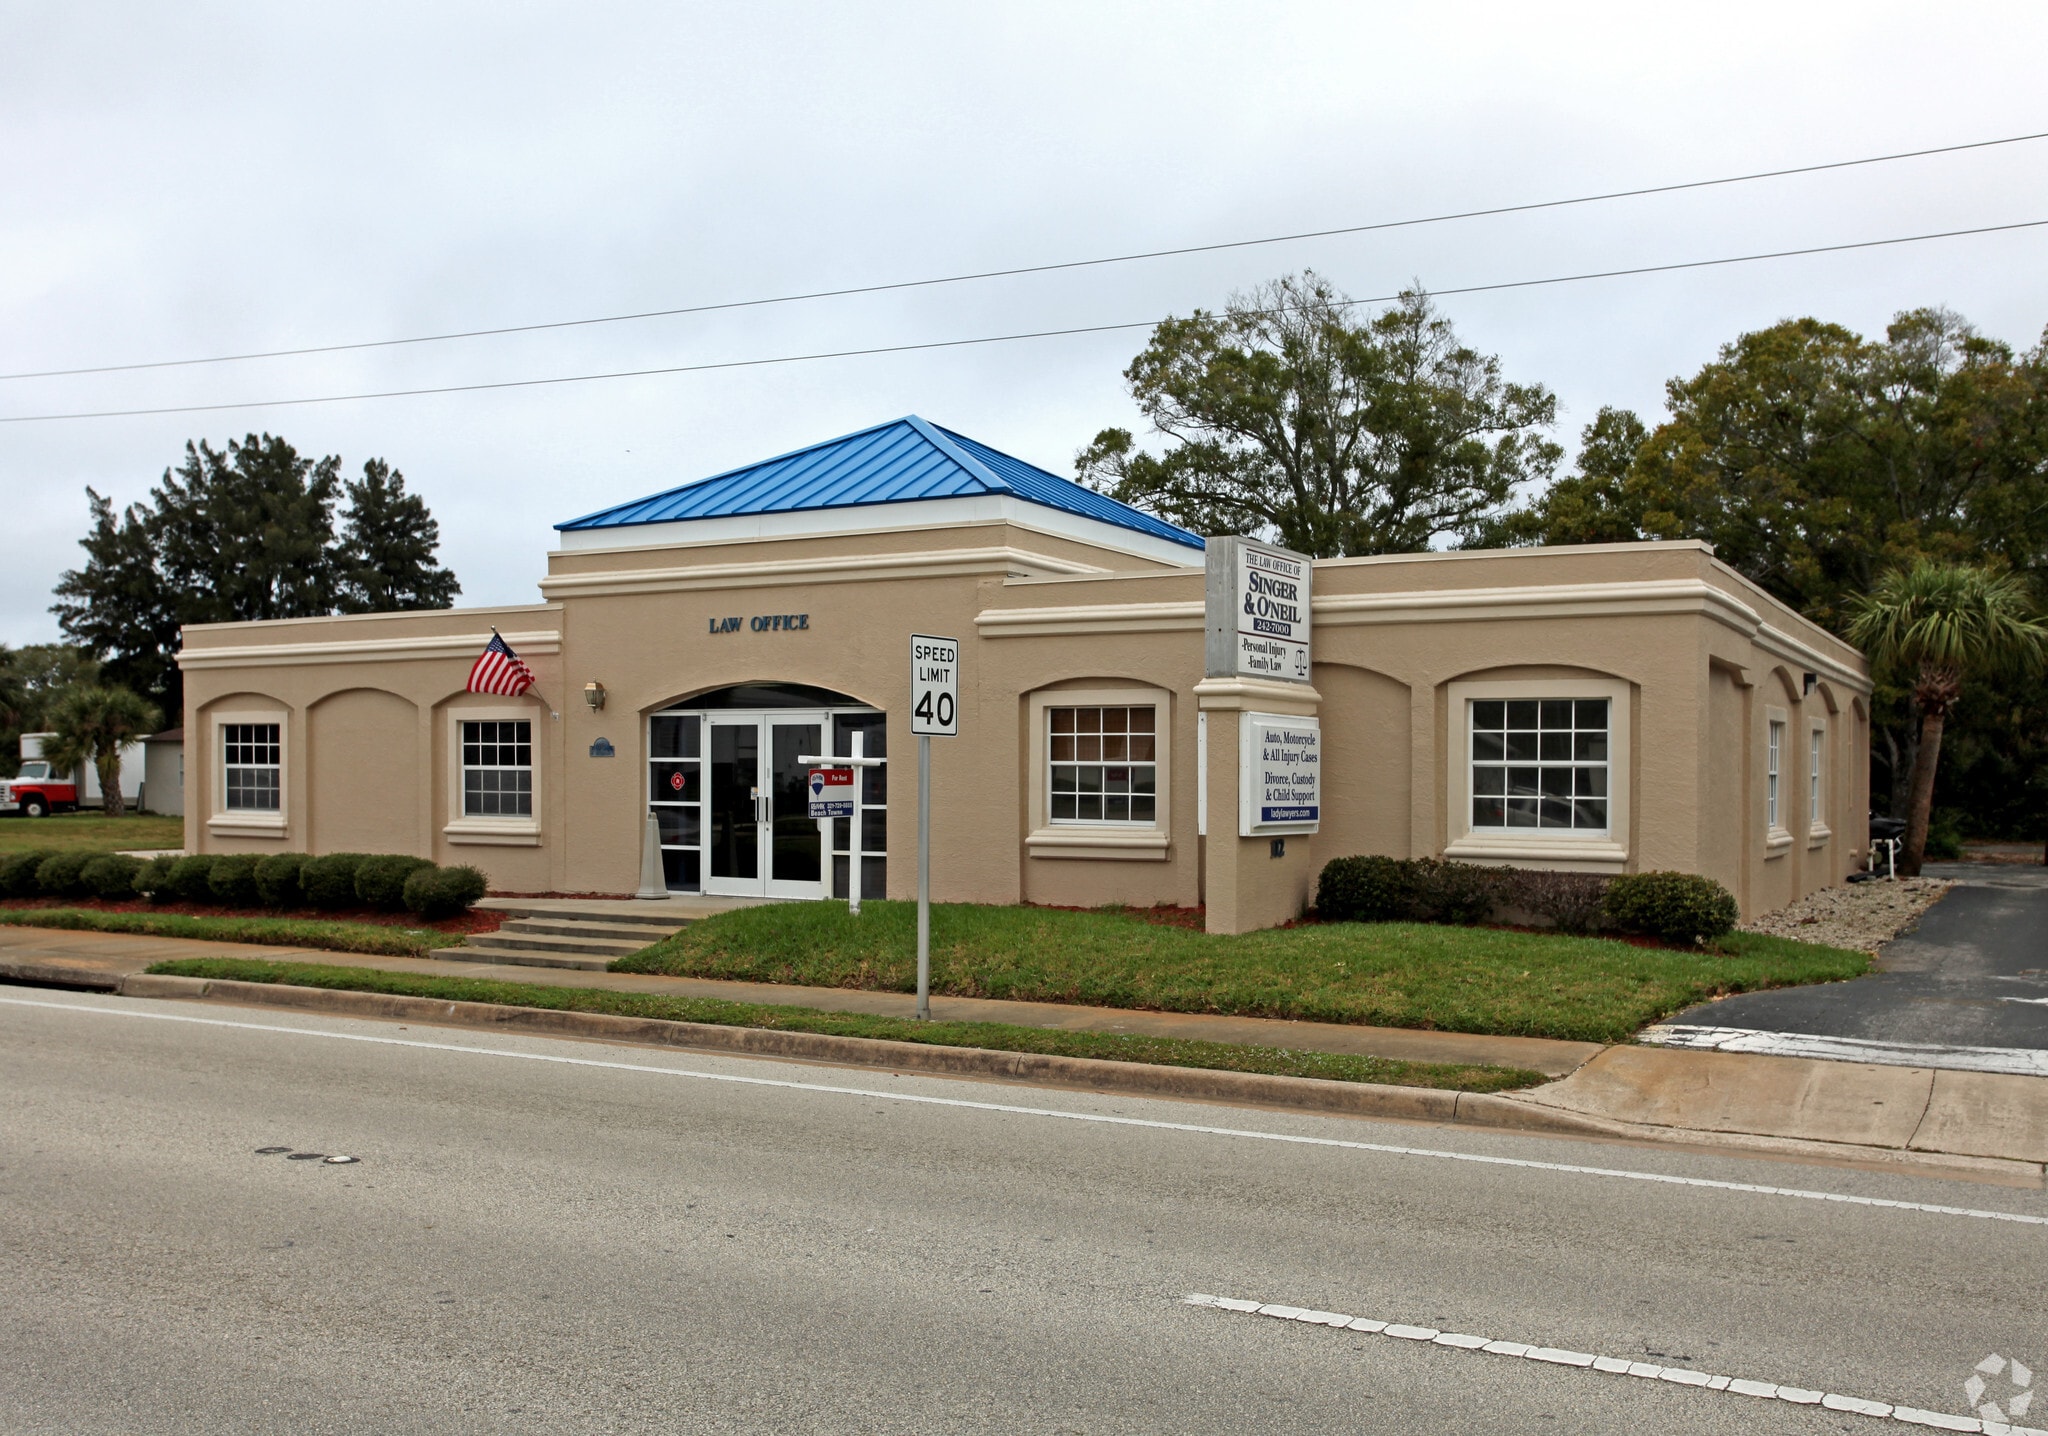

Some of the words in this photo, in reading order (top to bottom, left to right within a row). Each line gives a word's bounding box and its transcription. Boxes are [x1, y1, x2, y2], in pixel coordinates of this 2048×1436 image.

[1246, 553, 1258, 565] THE
[1259, 555, 1271, 568] LAW
[1272, 558, 1292, 573] OFFICE
[1293, 563, 1301, 575] OF
[1248, 571, 1298, 601] SINGER
[1244, 592, 1256, 615] &
[1257, 596, 1301, 624] O'NEIL
[709, 617, 743, 633] LAW
[750, 614, 809, 632] OFFICE
[1256, 619, 1289, 634] 242-7000
[915, 645, 955, 663] SPEED
[1269, 642, 1286, 659] Injury
[1270, 657, 1282, 671] Law
[920, 667, 950, 683] LIMIT
[915, 690, 954, 726] 40
[1265, 730, 1282, 746] Auto,
[1283, 732, 1316, 748] Motorcycle
[1263, 748, 1269, 761] &
[1270, 749, 1280, 761] All
[1281, 749, 1300, 766] Injury
[1301, 750, 1318, 763] Cases
[1265, 771, 1290, 787] Divorce,
[1291, 772, 1315, 788] Custody
[1265, 788, 1272, 801] &
[1273, 788, 1290, 801] Child
[1291, 789, 1315, 805] Support
[810, 809, 826, 817] Beach
[1270, 808, 1310, 820] ladylawyers.com
